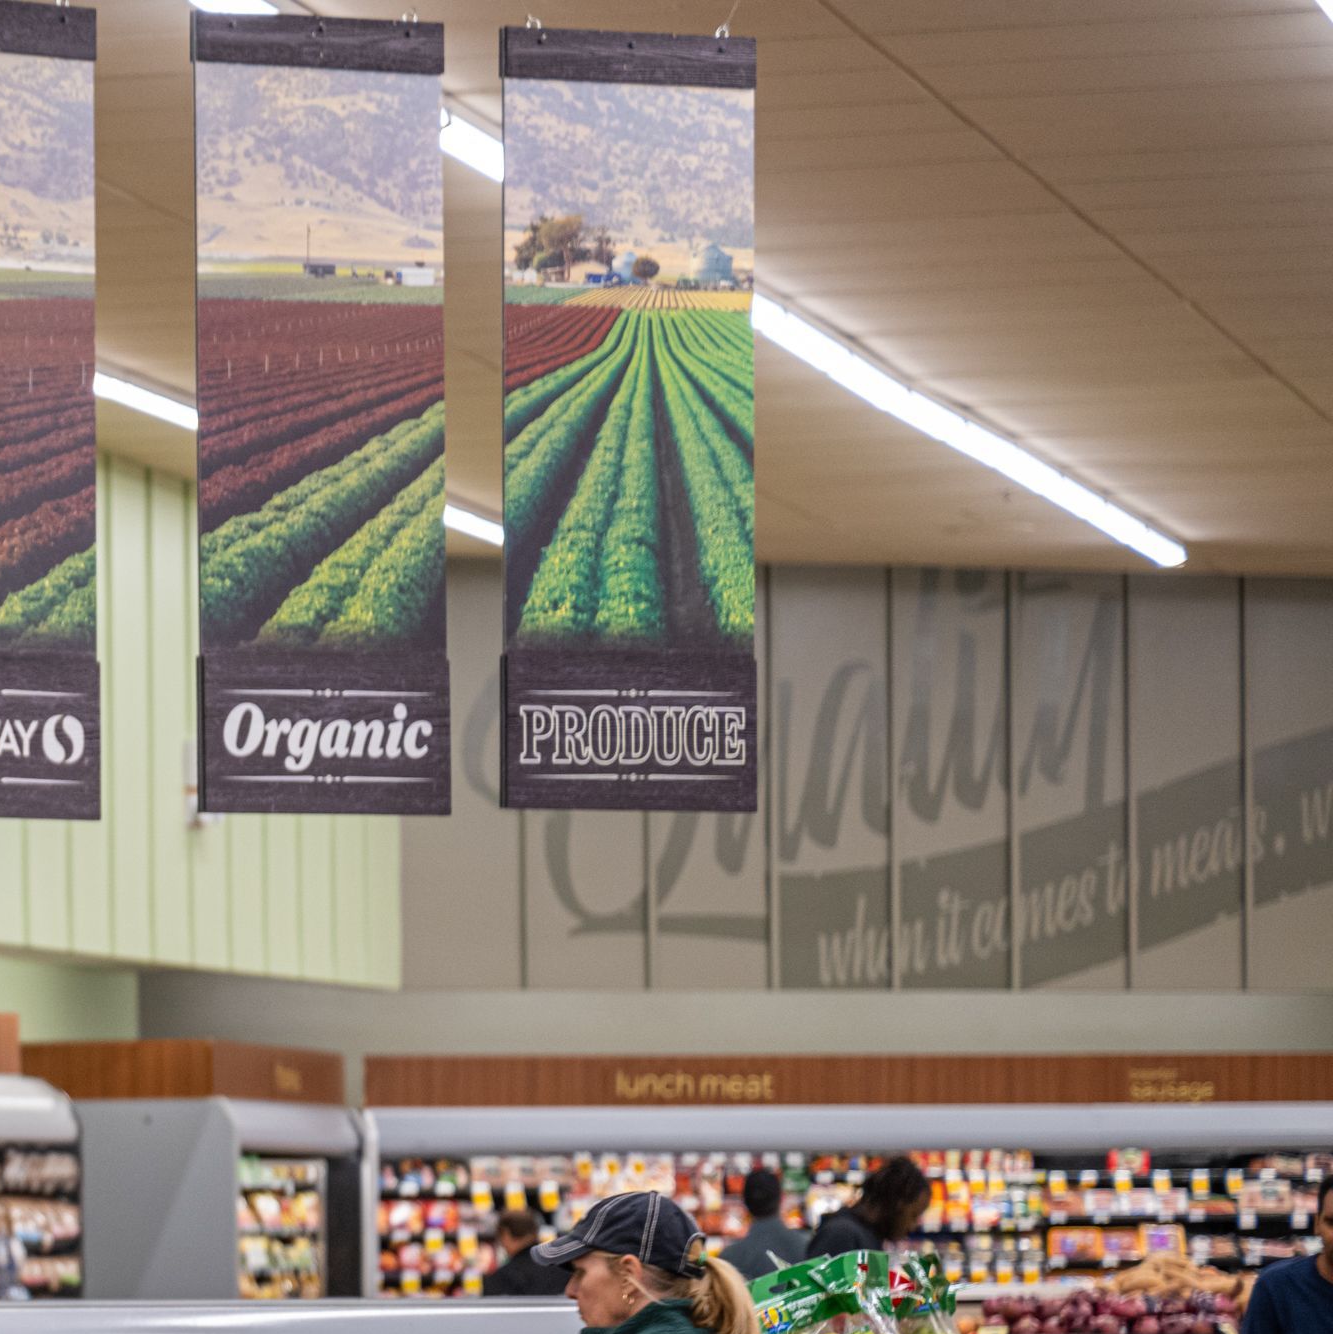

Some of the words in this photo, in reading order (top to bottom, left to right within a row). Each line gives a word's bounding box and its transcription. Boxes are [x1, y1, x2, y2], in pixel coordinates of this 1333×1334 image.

[223, 701, 434, 772] Organic
[518, 703, 746, 767] PRODUCE
[615, 1070, 694, 1098] lunch
[700, 1072, 773, 1098] meat
